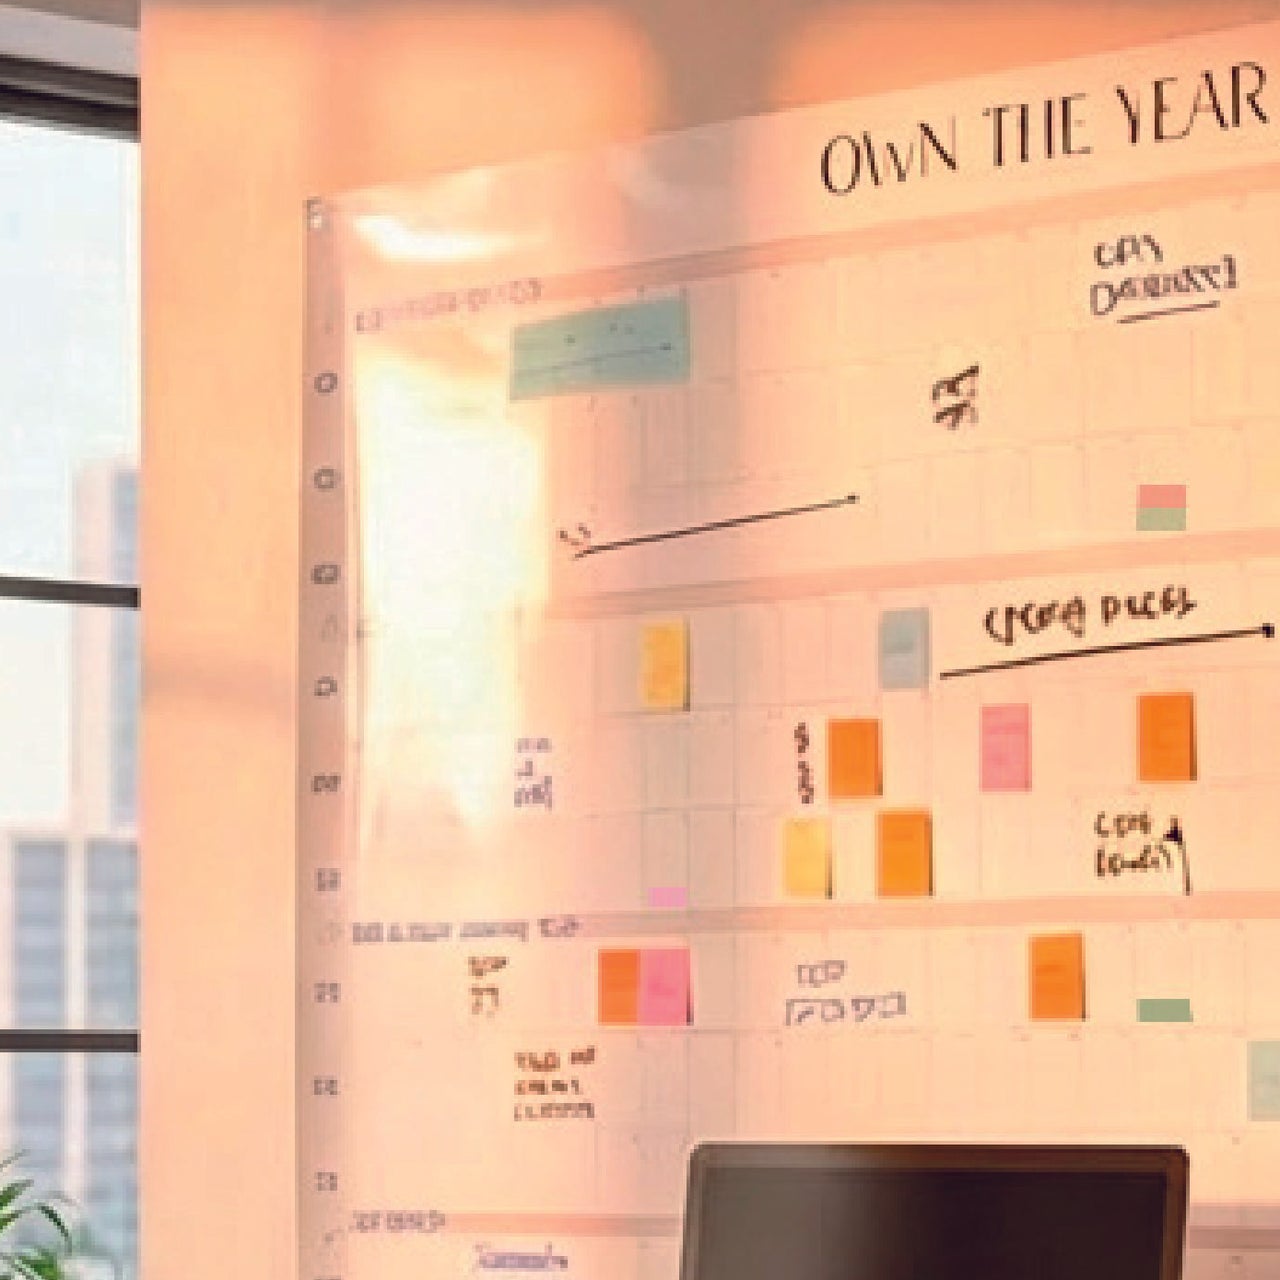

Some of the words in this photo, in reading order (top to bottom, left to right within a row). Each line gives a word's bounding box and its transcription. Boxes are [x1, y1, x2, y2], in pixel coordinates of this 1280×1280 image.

[820, 115, 958, 195] OWN
[982, 92, 1093, 167] THE
[1114, 61, 1270, 145] YEAR
